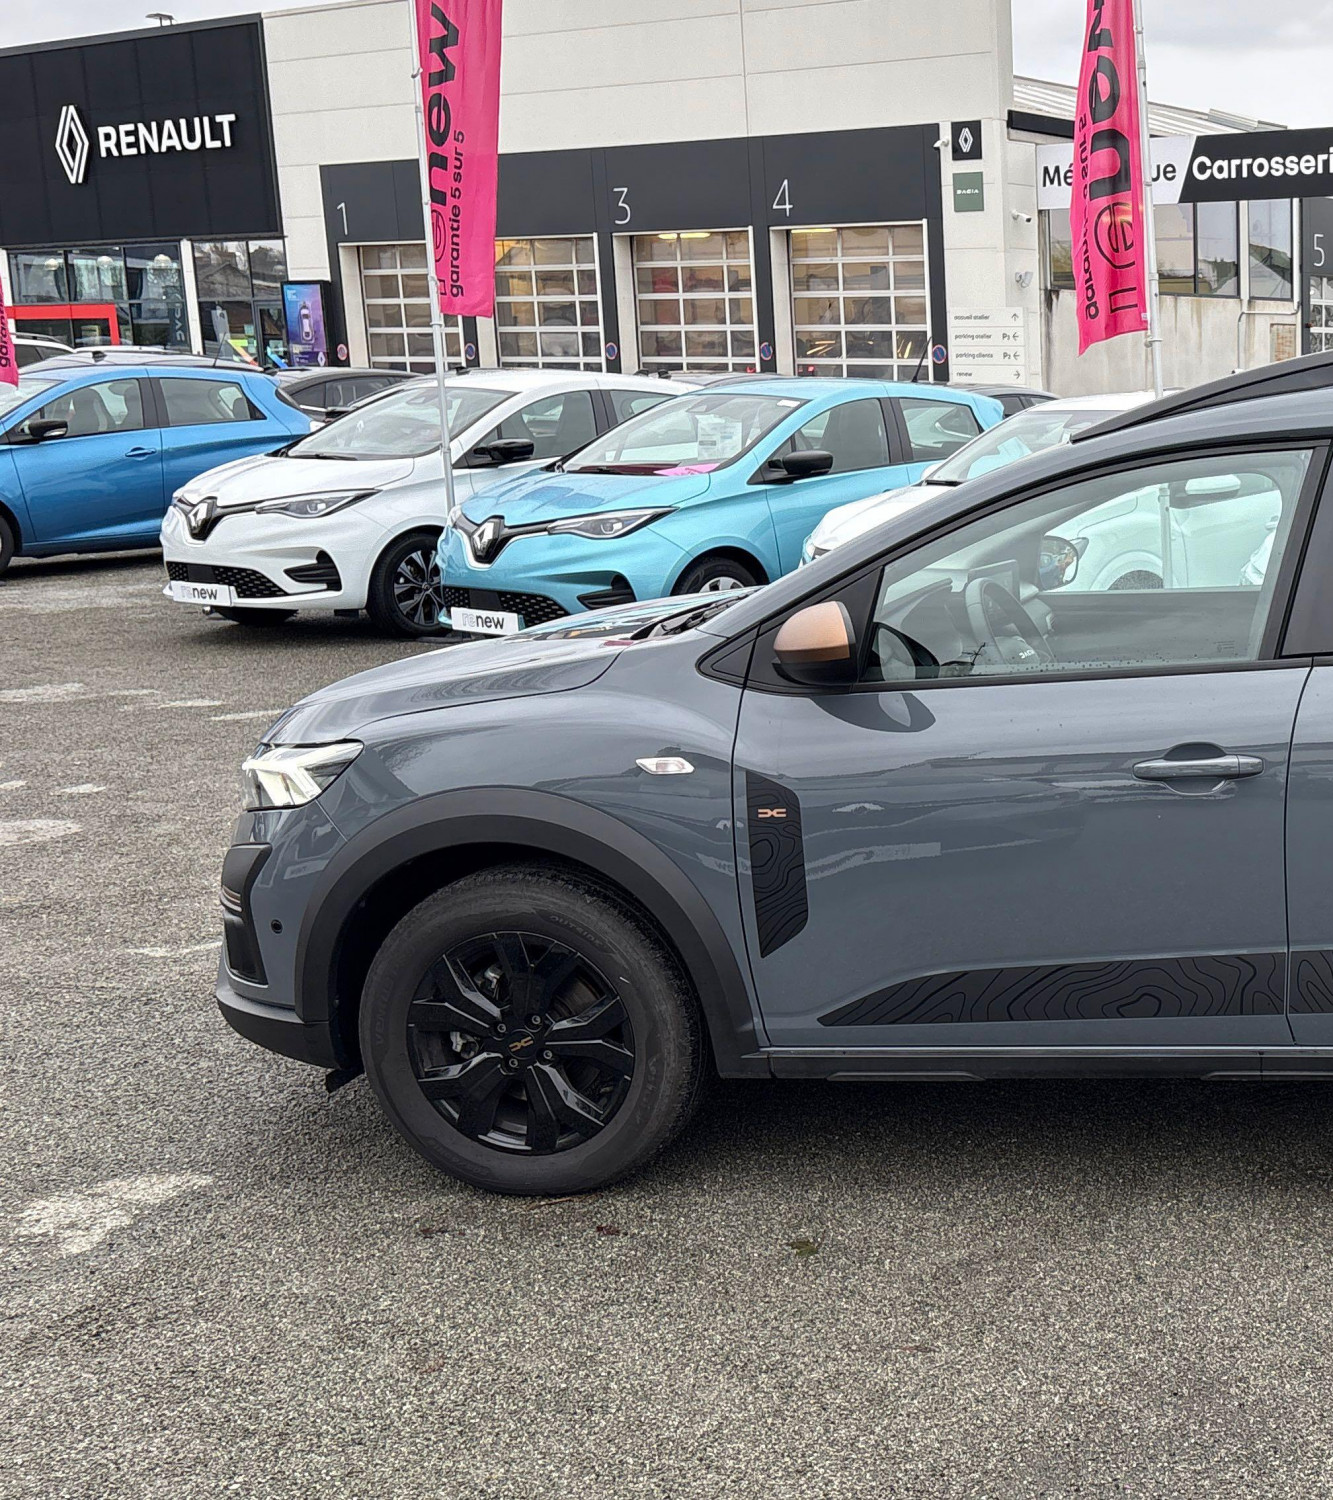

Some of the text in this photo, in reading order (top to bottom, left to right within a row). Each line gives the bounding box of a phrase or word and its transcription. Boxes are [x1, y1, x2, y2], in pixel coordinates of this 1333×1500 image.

[97, 113, 236, 158] RENAULT
[449, 130, 465, 298] garantie 5 sur 5
[613, 187, 632, 225] 3
[772, 178, 793, 217] 4
[336, 202, 348, 236] 1
[1313, 233, 1325, 267] 5
[954, 333, 975, 341] parking
[1002, 332, 1011, 340] P3
[955, 352, 976, 360] parking
[462, 612, 505, 630] renew
